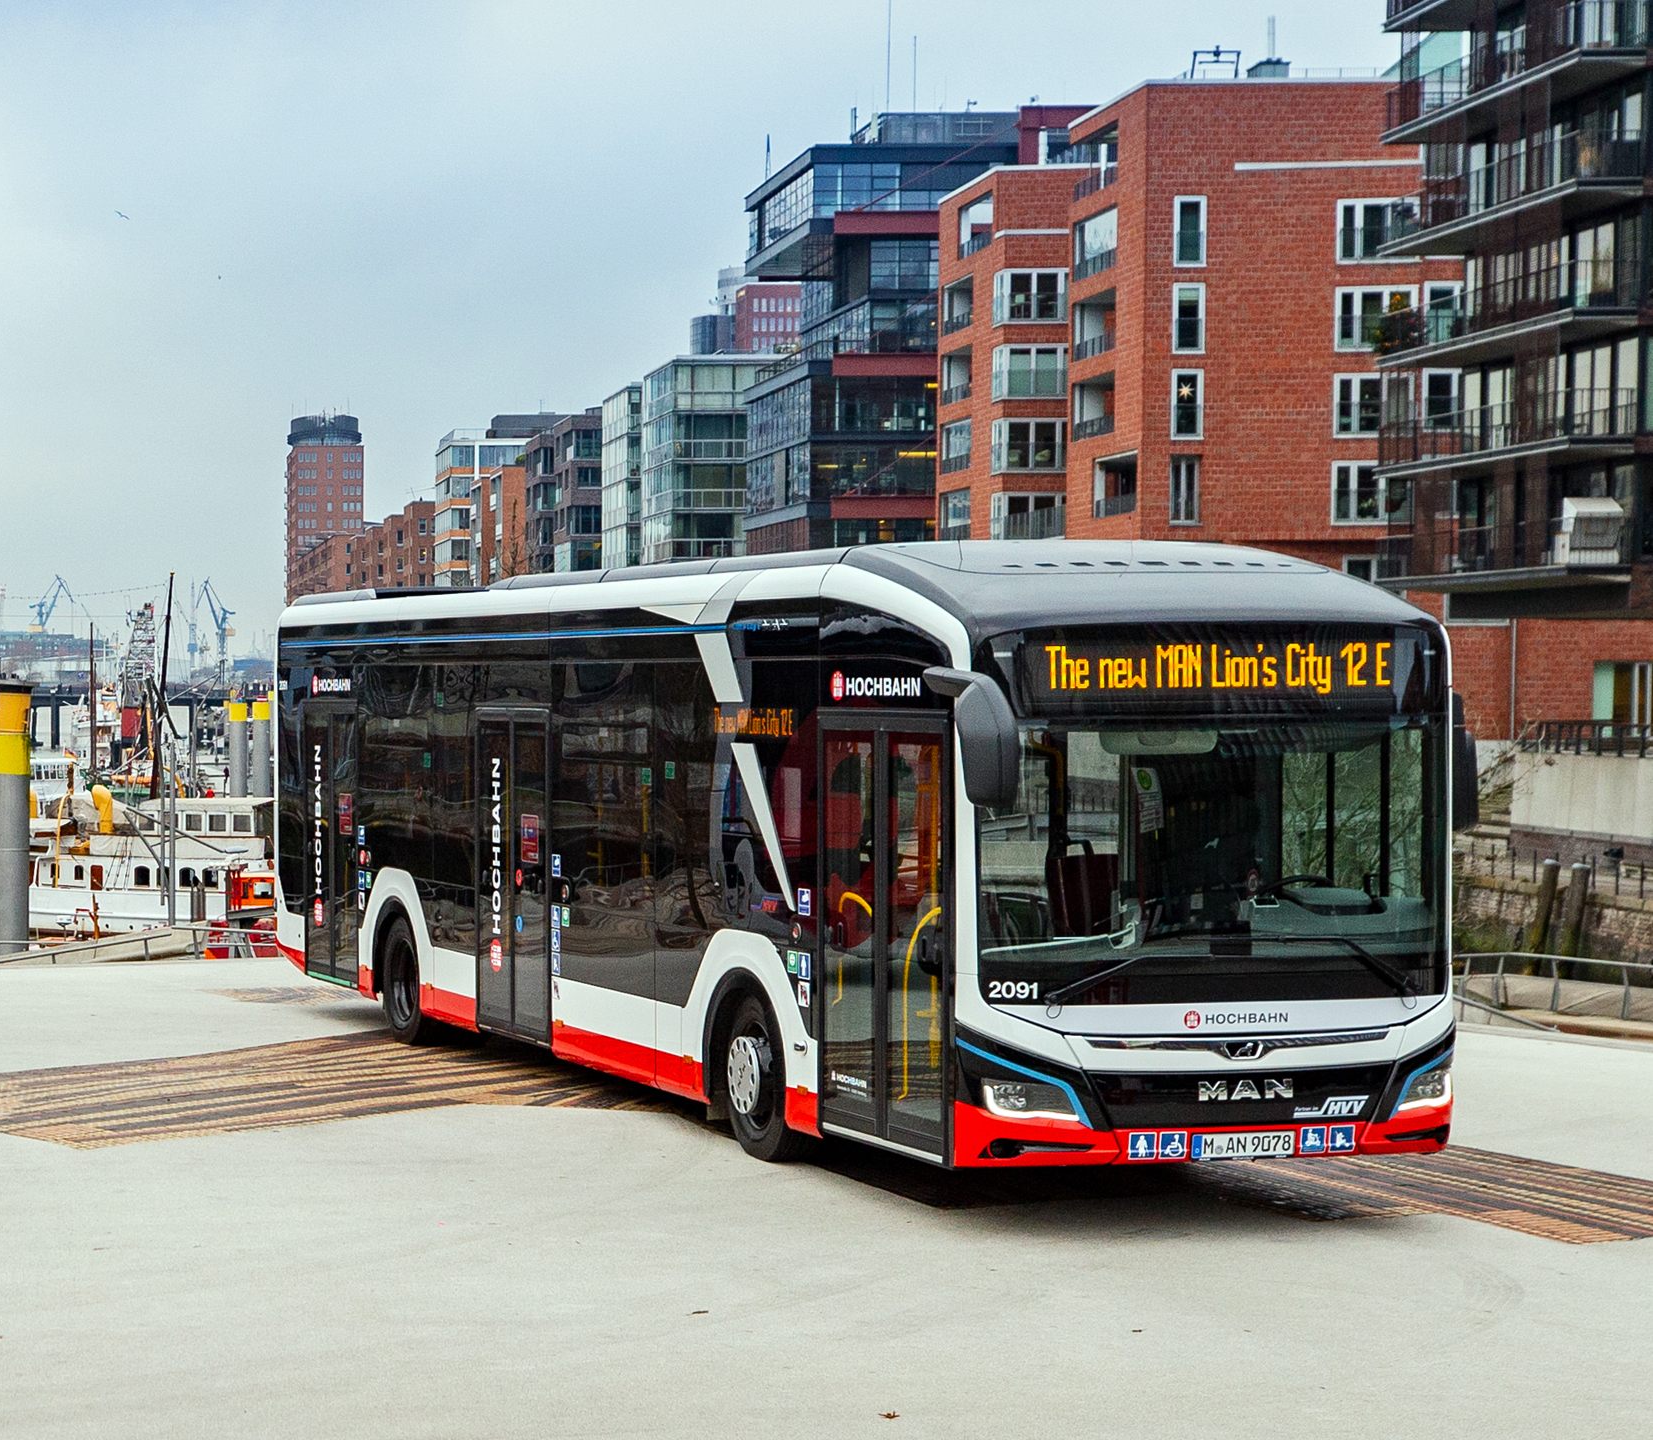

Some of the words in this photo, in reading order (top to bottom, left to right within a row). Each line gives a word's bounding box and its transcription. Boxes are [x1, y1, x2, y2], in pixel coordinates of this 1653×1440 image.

[1044, 644, 1090, 690] The
[1098, 657, 1147, 690] new
[1156, 644, 1203, 689] MAN
[1211, 643, 1278, 688] Lion's
[1285, 642, 1332, 695] City
[1340, 642, 1368, 687] 12
[1375, 642, 1391, 687] E
[318, 678, 351, 692] HOCHBAHN
[845, 677, 921, 697] HOCHBAHN
[767, 708, 779, 737] City
[788, 708, 793, 735] E
[314, 745, 322, 895] HOCHBAHN
[492, 758, 502, 935] HOCHBAHN
[988, 980, 1039, 1000] 2091
[1205, 1012, 1289, 1025] HOCHBAHN
[1198, 1078, 1294, 1101] MAN
[1327, 1100, 1367, 1115] HVV
[1203, 1137, 1214, 1155] M
[1225, 1136, 1247, 1153] AN
[1251, 1134, 1291, 1153] 9078
